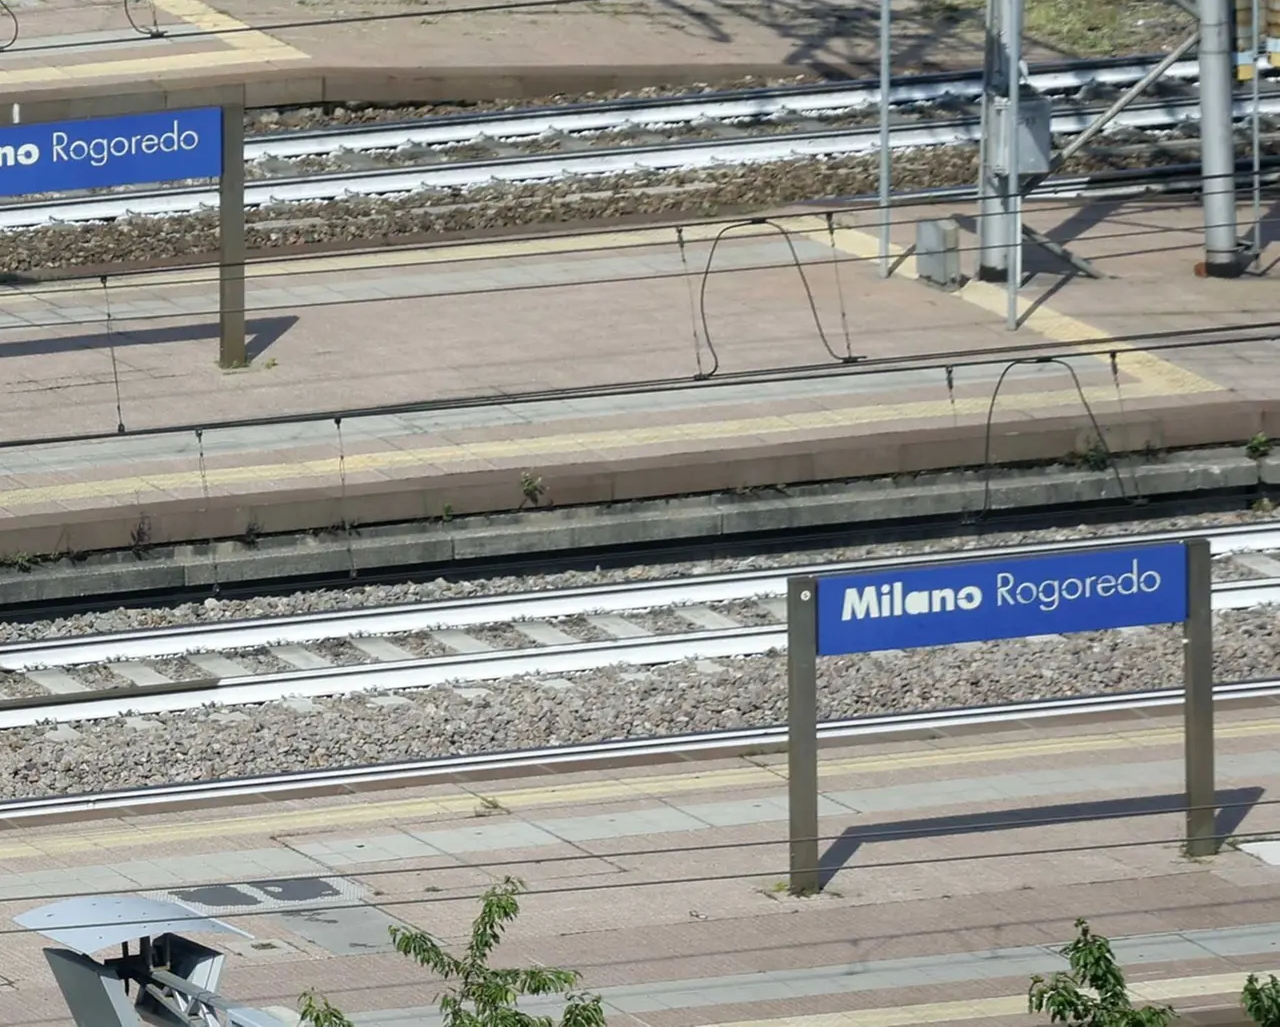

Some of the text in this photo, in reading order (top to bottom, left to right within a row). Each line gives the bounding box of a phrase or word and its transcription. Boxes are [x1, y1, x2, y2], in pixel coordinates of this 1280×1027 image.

[52, 120, 199, 167] Rogoredo
[842, 559, 1162, 622] Milano Rogoredo
